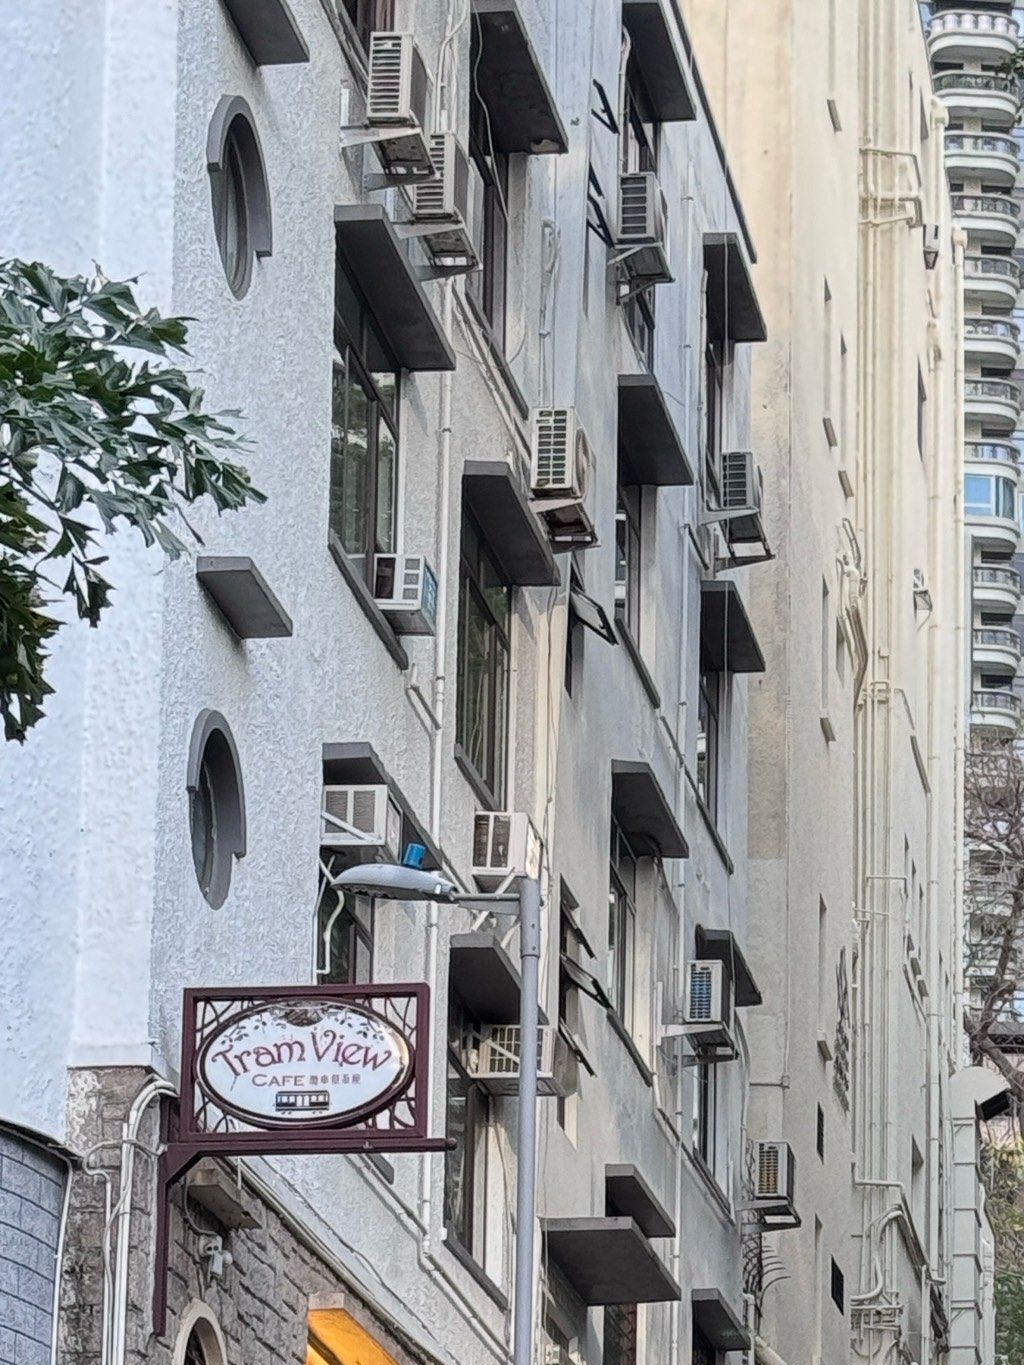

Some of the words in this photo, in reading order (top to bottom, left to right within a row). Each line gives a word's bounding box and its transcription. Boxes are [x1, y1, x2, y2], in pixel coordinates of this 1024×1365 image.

[211, 1040, 306, 1077] Tram
[310, 1028, 393, 1072] View
[251, 1073, 305, 1088] CAFE
